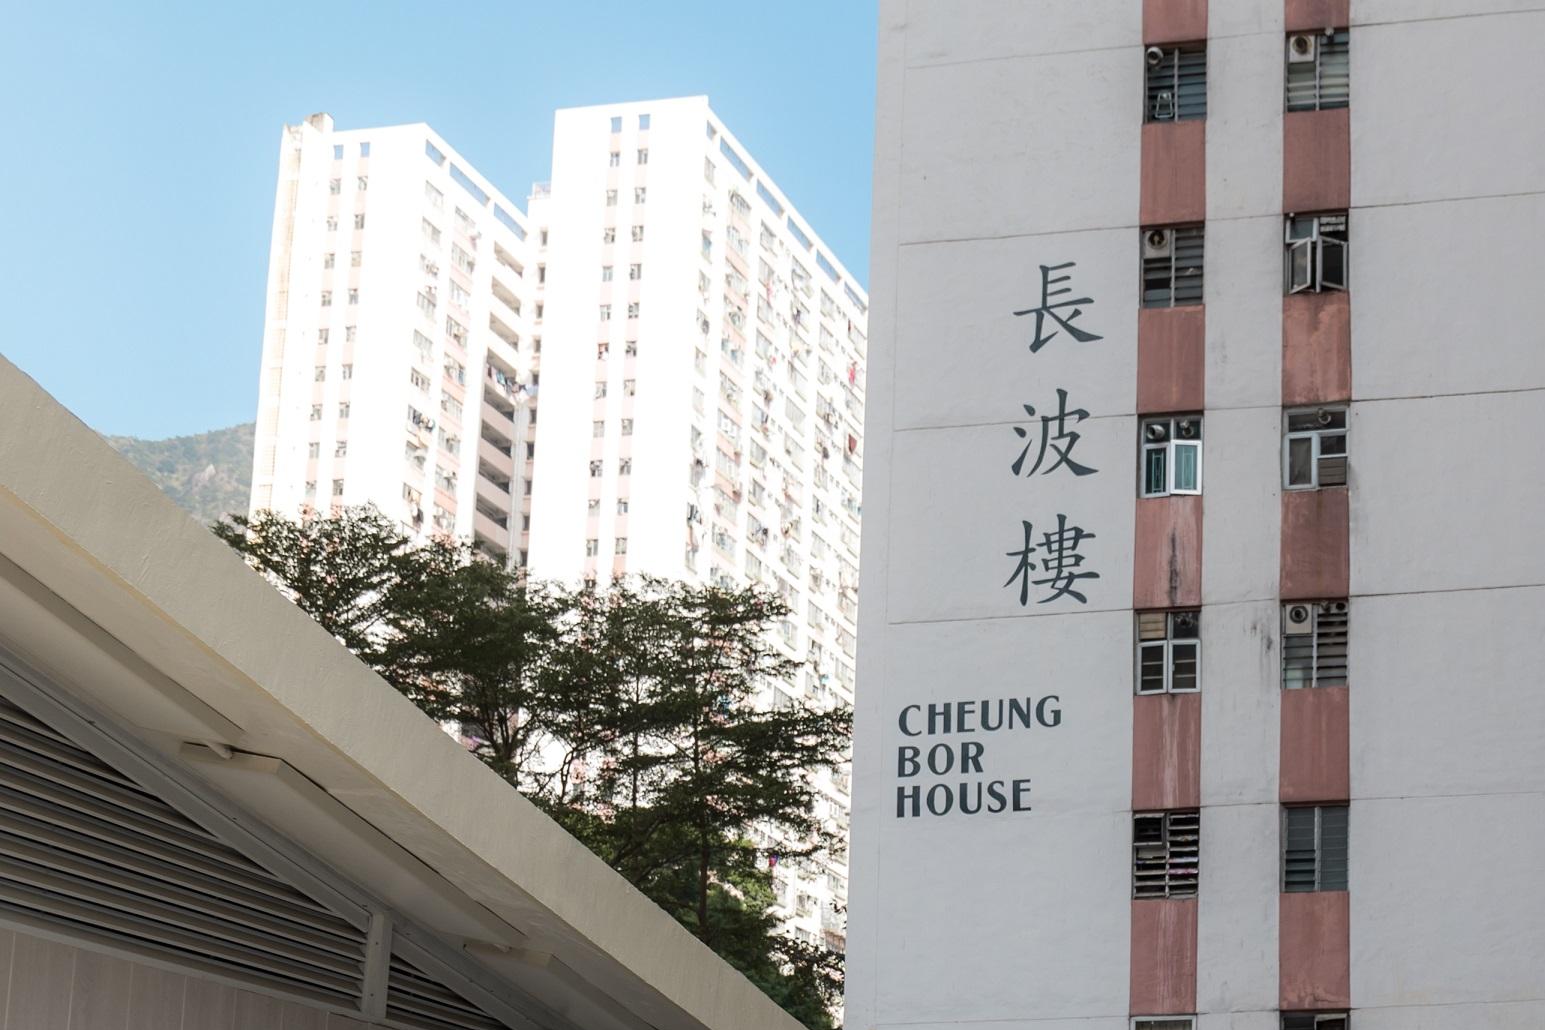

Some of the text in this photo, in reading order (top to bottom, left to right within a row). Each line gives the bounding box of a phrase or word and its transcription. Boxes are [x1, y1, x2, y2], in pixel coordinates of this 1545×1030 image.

[1003, 261, 1104, 606] 長波樓
[898, 695, 1062, 738] CHEUNG
[897, 740, 985, 778] BOR
[896, 779, 1032, 818] HOUSE
